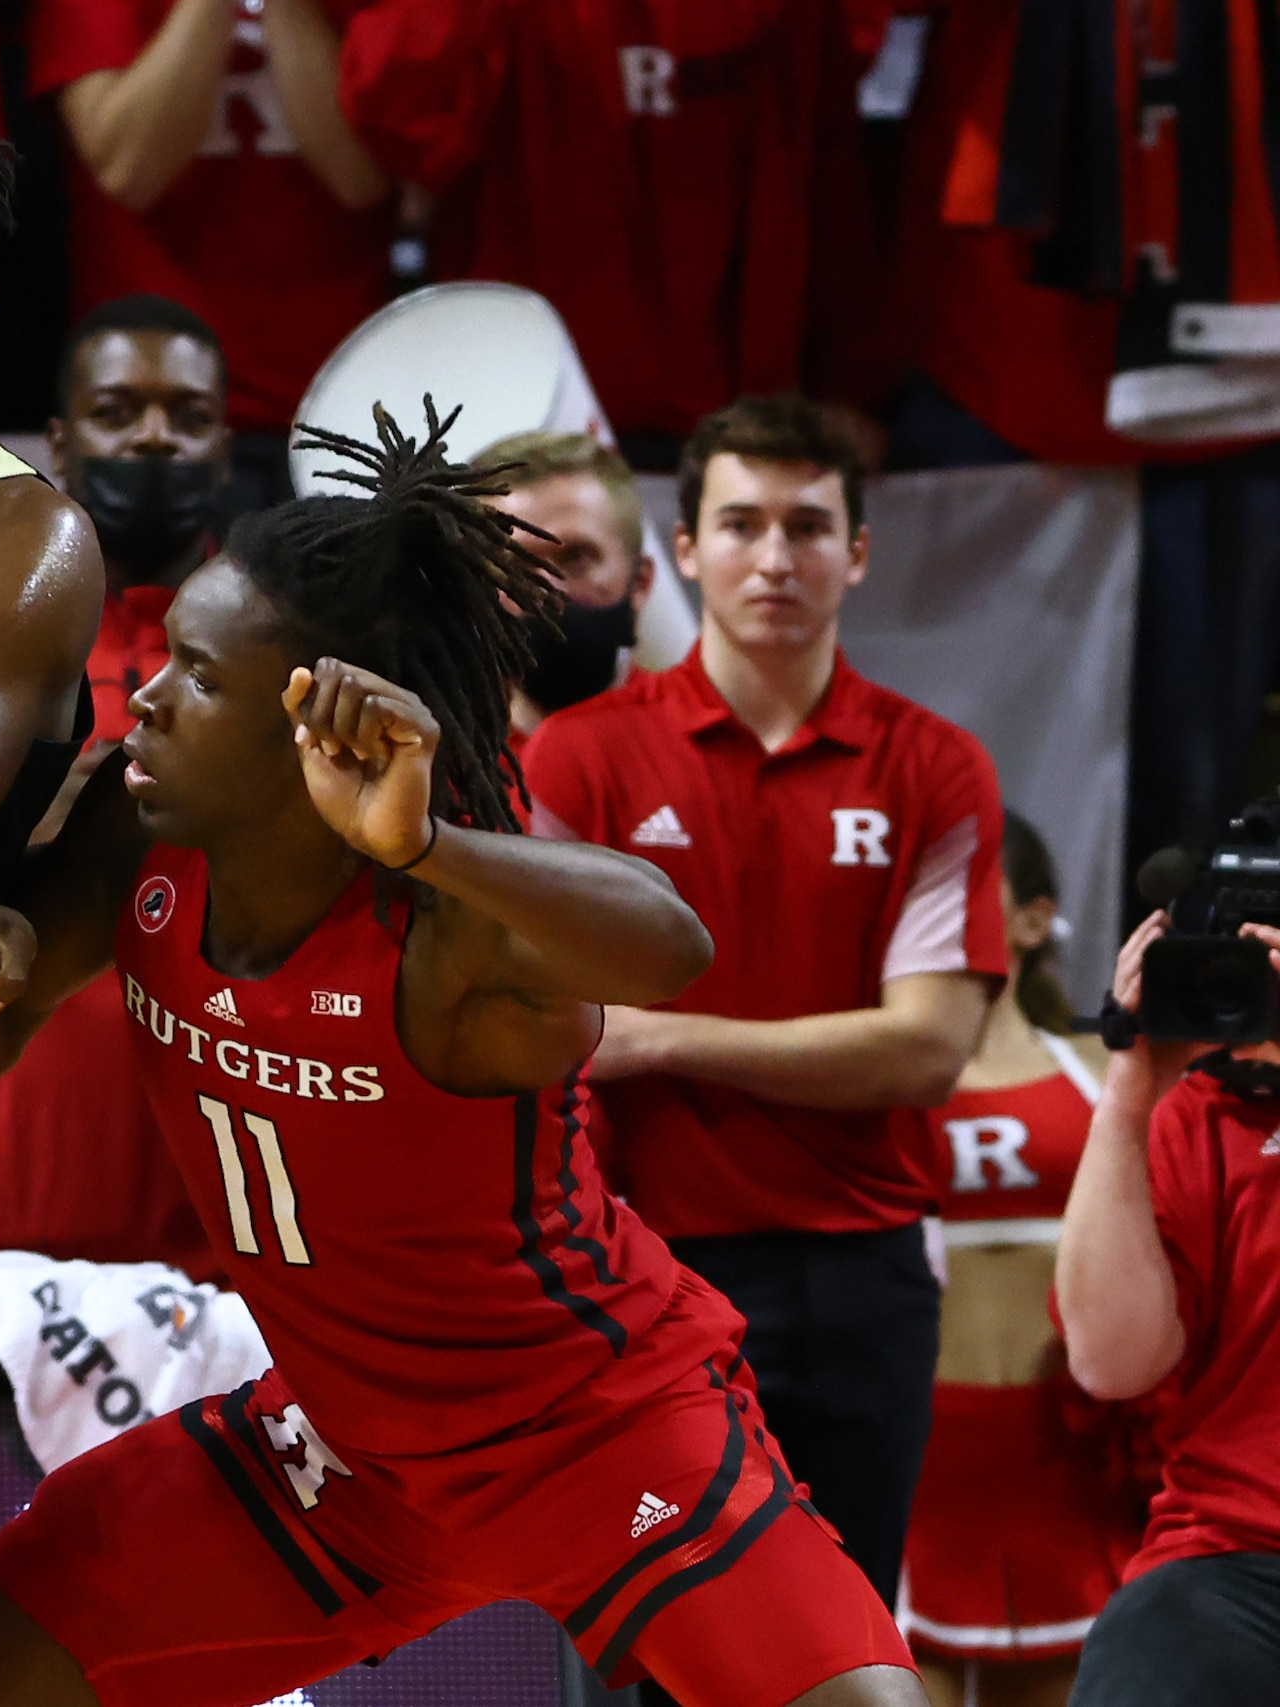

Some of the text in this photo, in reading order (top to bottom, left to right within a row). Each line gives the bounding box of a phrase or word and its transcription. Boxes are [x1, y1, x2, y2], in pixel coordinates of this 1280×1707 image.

[617, 45, 677, 117] R
[830, 808, 892, 866] R
[126, 972, 385, 1102] RUTGERS
[203, 1001, 246, 1028] adidas
[198, 1093, 312, 1266] 11
[944, 1115, 1040, 1192] R
[630, 1503, 680, 1539] adidas
